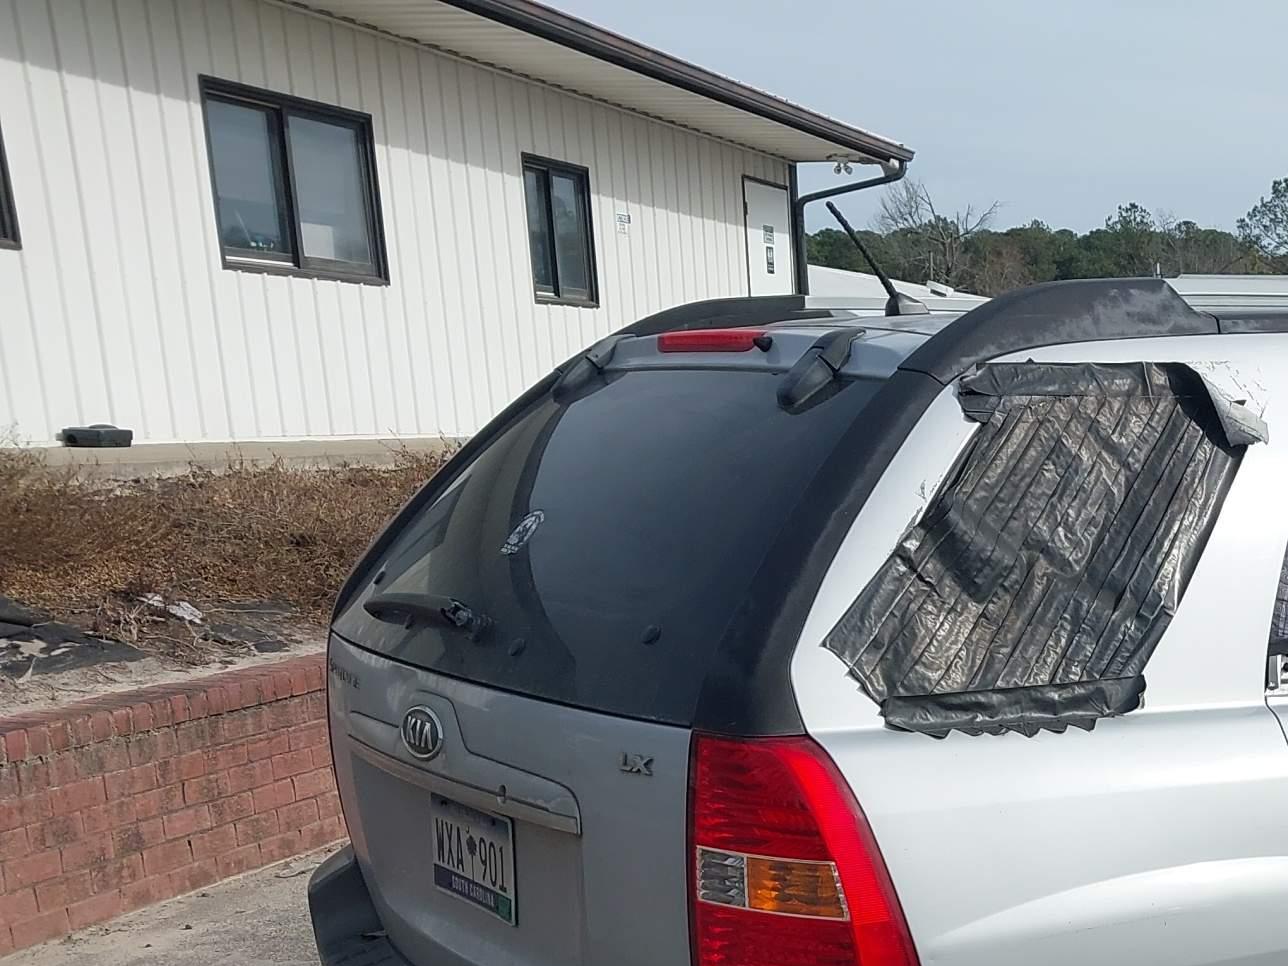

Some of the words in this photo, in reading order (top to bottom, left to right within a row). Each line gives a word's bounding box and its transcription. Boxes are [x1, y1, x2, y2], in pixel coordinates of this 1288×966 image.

[405, 715, 433, 750] KIA
[621, 752, 654, 777] LX
[435, 817, 465, 873] WXA
[478, 836, 508, 893] 901
